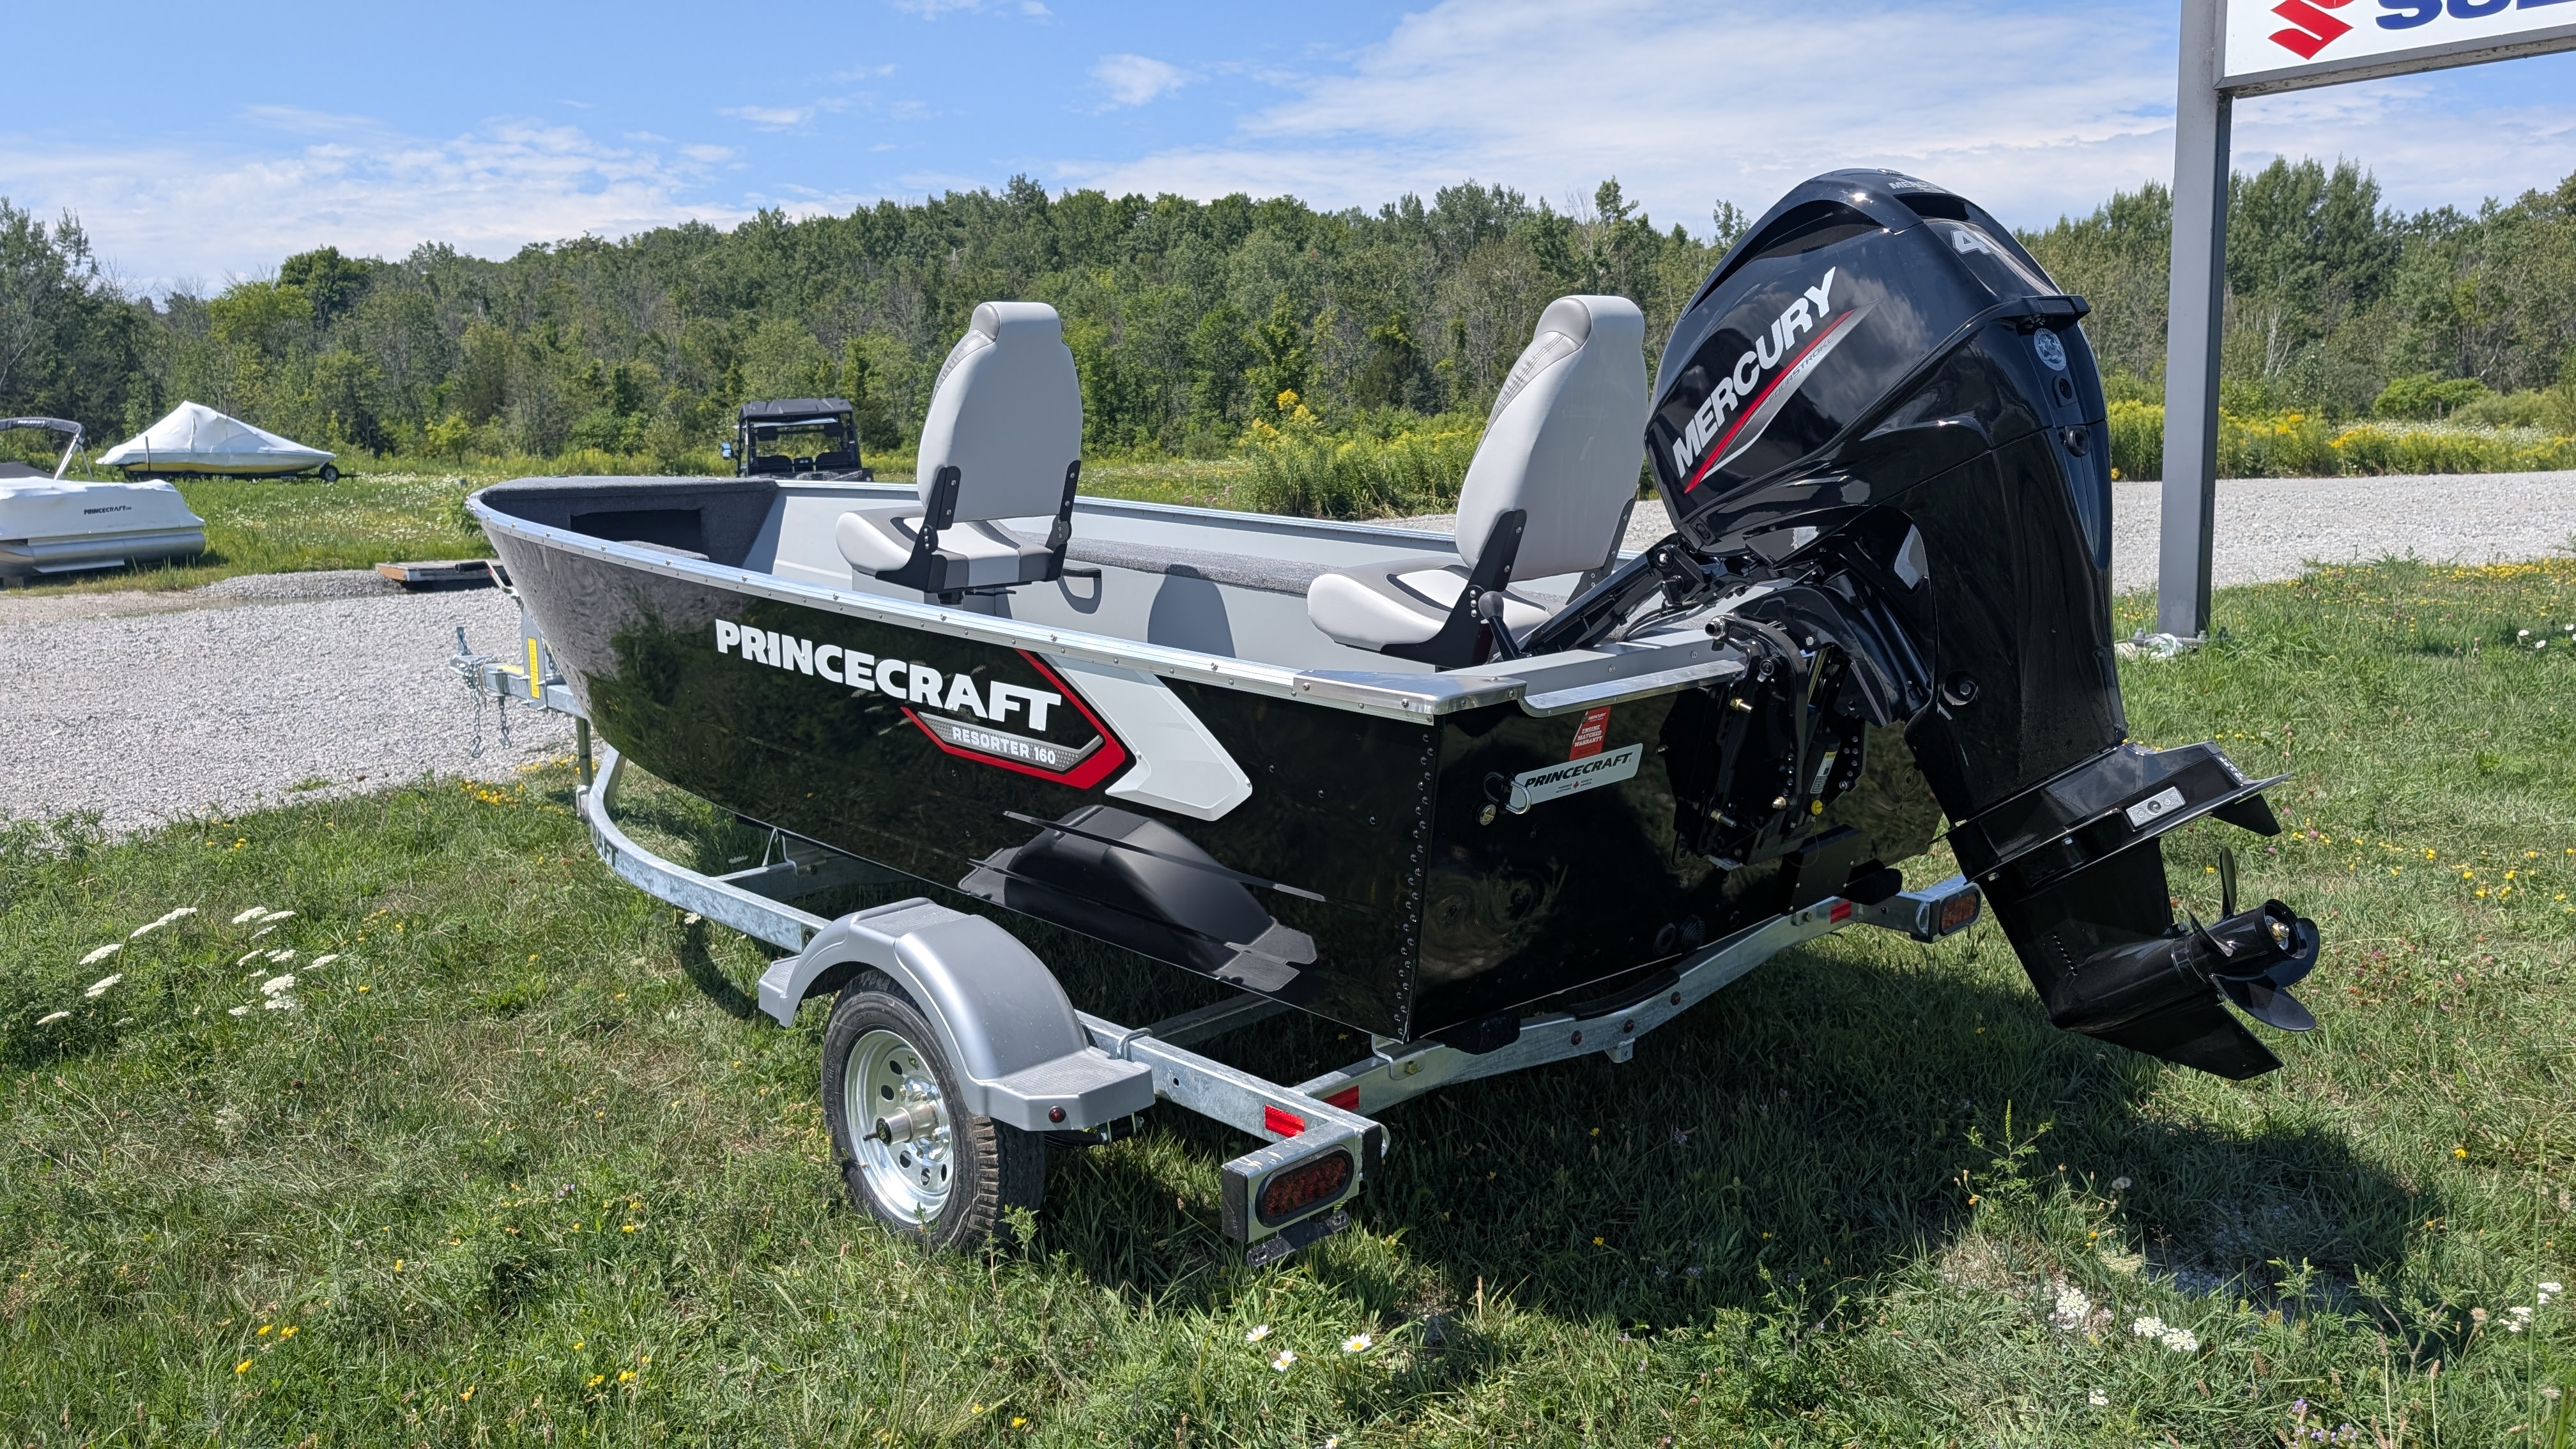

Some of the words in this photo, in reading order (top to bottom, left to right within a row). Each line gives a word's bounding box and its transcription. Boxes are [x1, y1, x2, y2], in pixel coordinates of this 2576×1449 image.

[1672, 266, 1836, 479] MERCURY
[1768, 335, 1834, 404] FOURSTROKE
[715, 619, 1061, 732] PRINCECRAFT
[952, 726, 1031, 759] RESORTER
[1034, 747, 1056, 765] 160
[1574, 735, 1603, 747] WARRANTY
[1577, 730, 1602, 741] MATCHED
[1524, 752, 1634, 788] PRINCECRAFT
